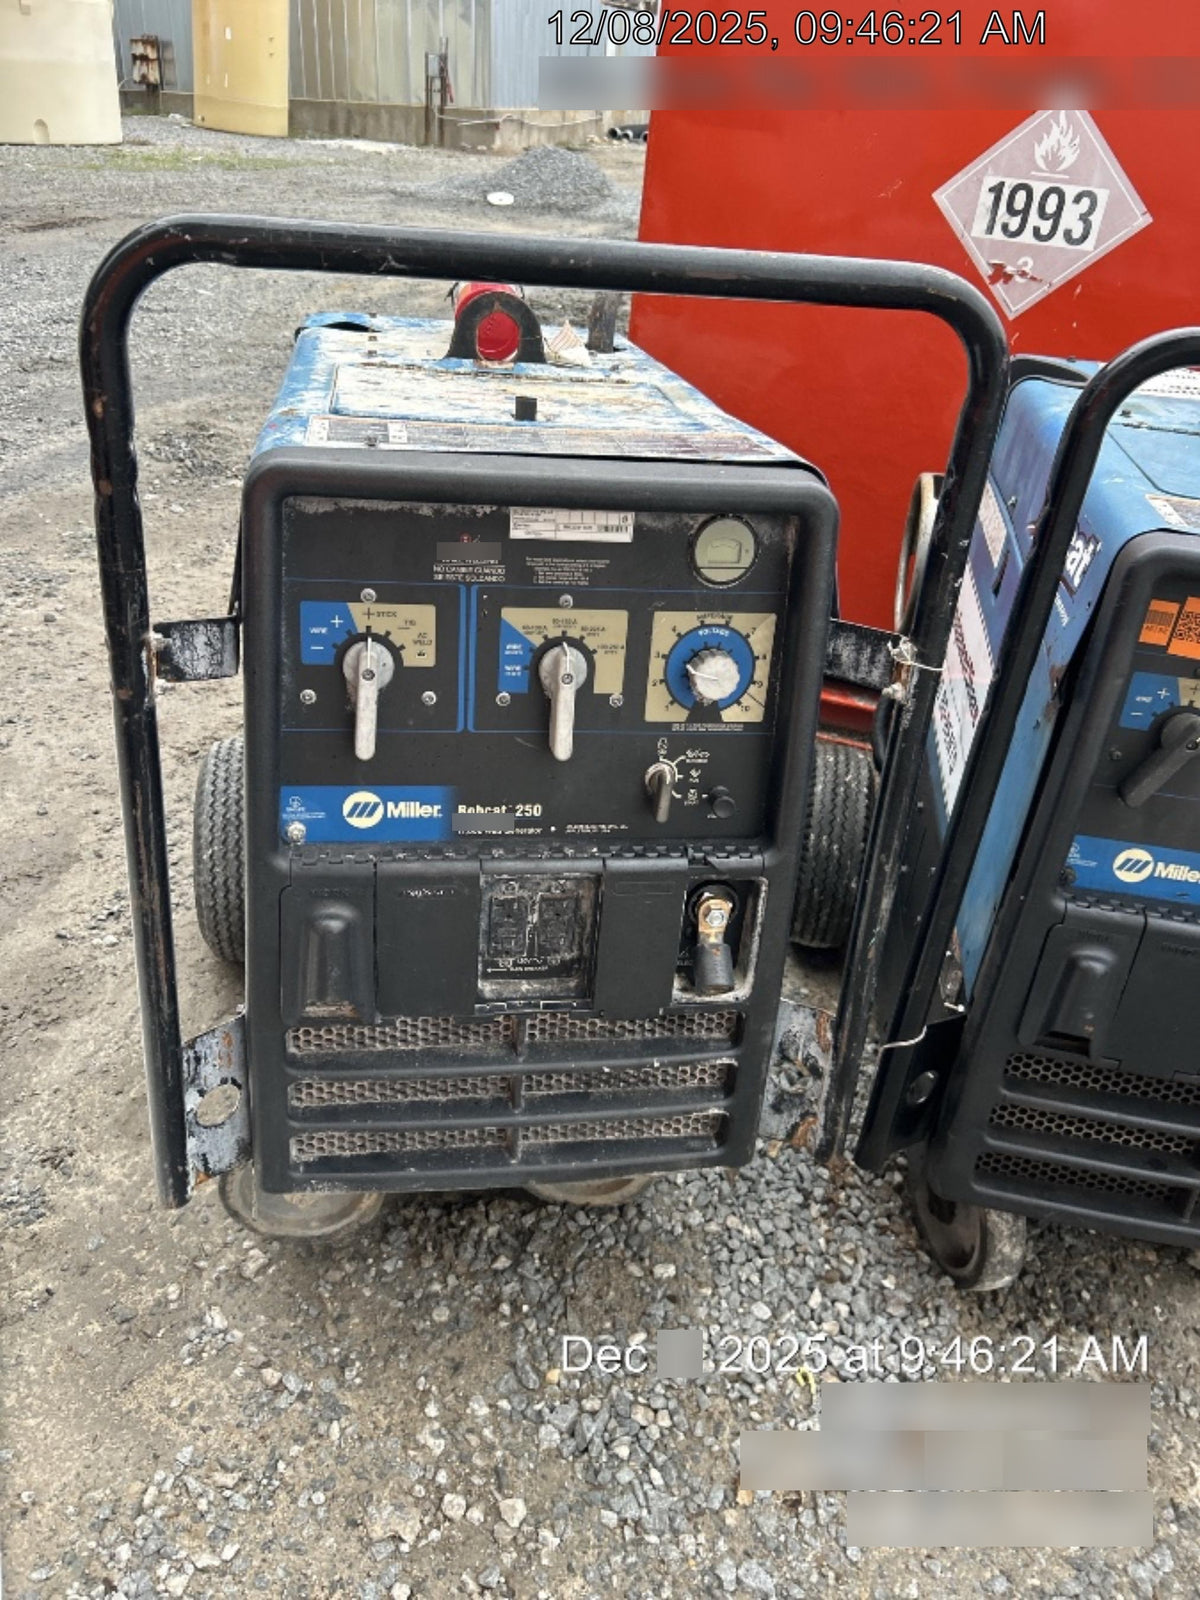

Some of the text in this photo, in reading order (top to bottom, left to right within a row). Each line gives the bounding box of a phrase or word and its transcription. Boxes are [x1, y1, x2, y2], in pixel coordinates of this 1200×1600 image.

[985, 181, 1098, 246] 1993
[387, 802, 440, 819] Miller
[515, 804, 542, 816] 250
[1154, 862, 1200, 885] Mille
